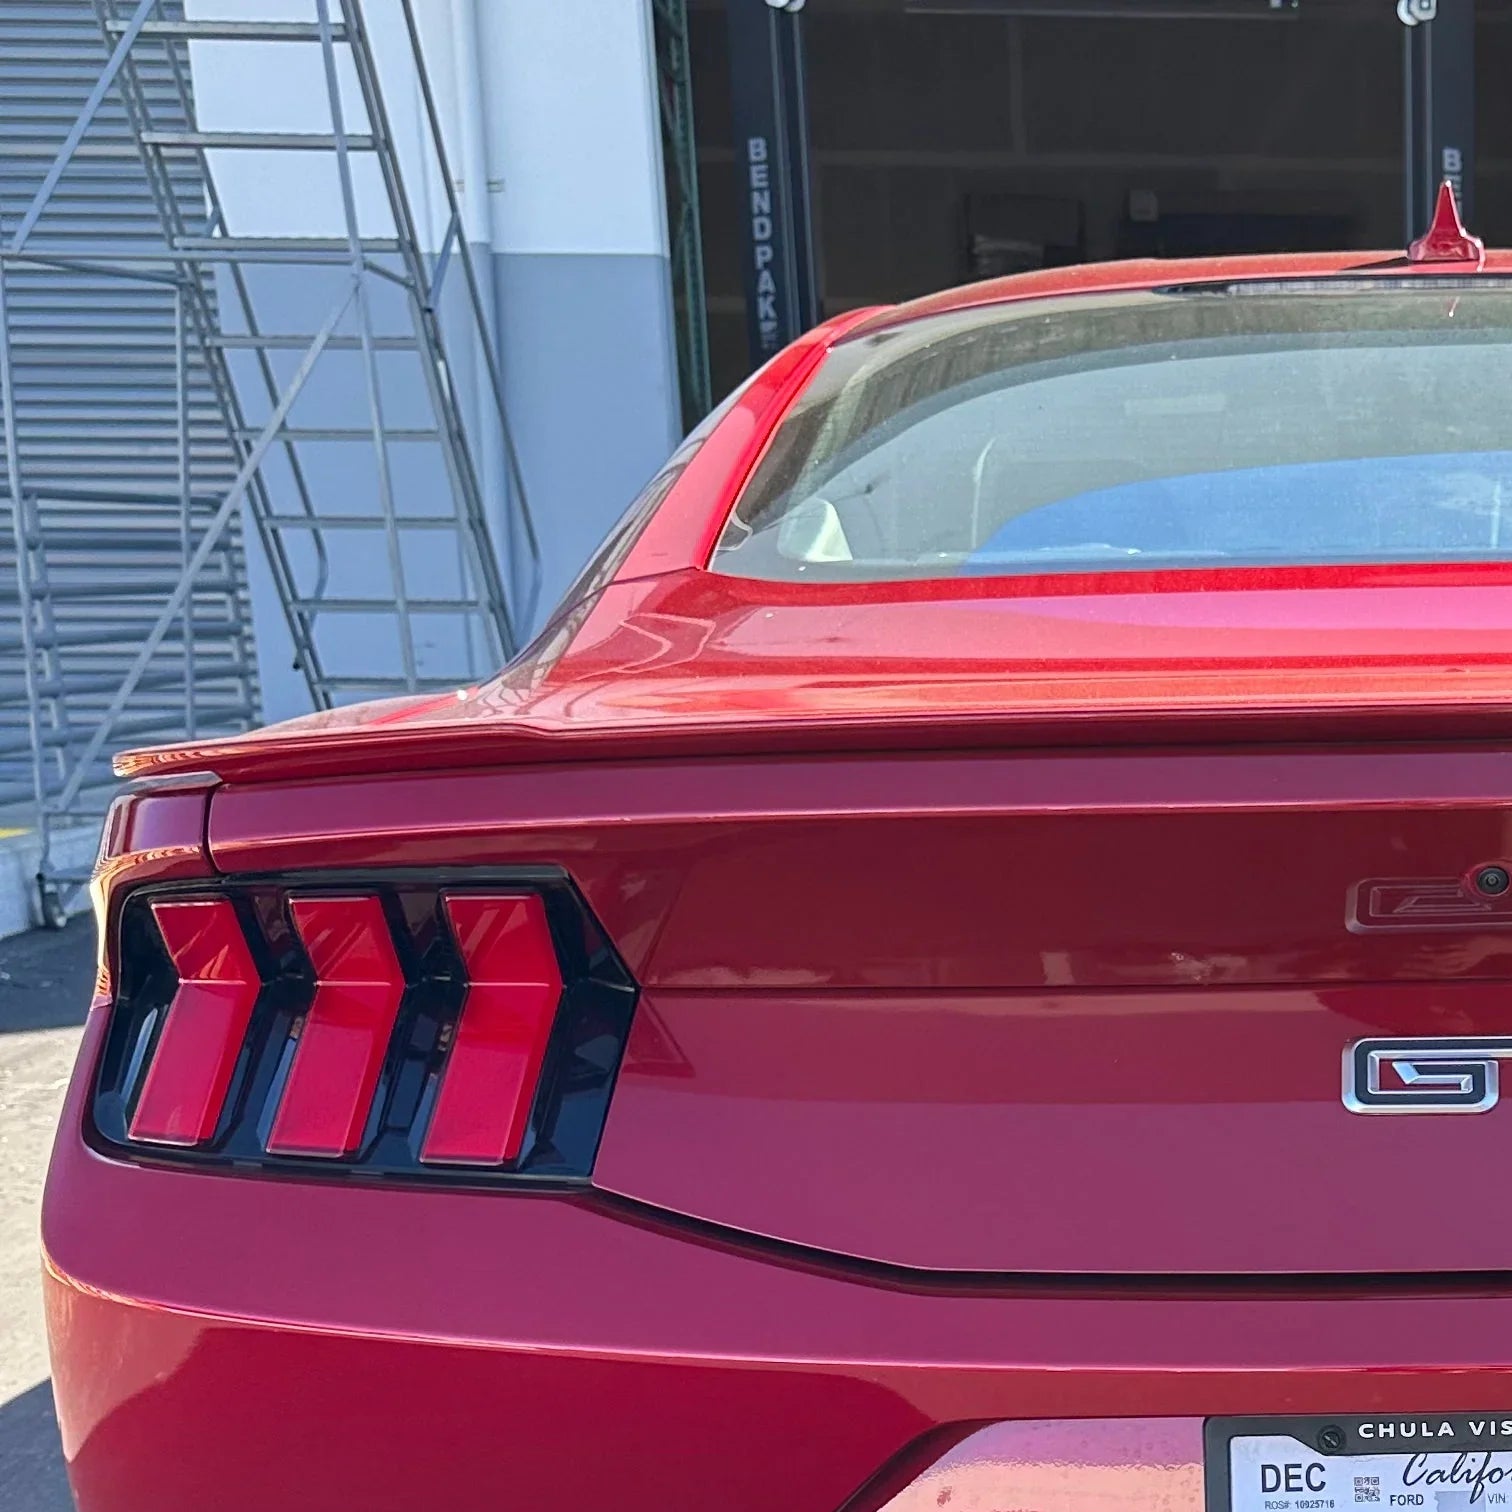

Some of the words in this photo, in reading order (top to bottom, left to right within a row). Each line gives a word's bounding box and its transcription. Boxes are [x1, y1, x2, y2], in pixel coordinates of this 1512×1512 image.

[1358, 1422, 1454, 1438] CHULA
[1261, 1463, 1326, 1492] DEC
[1389, 1494, 1424, 1507] FORD
